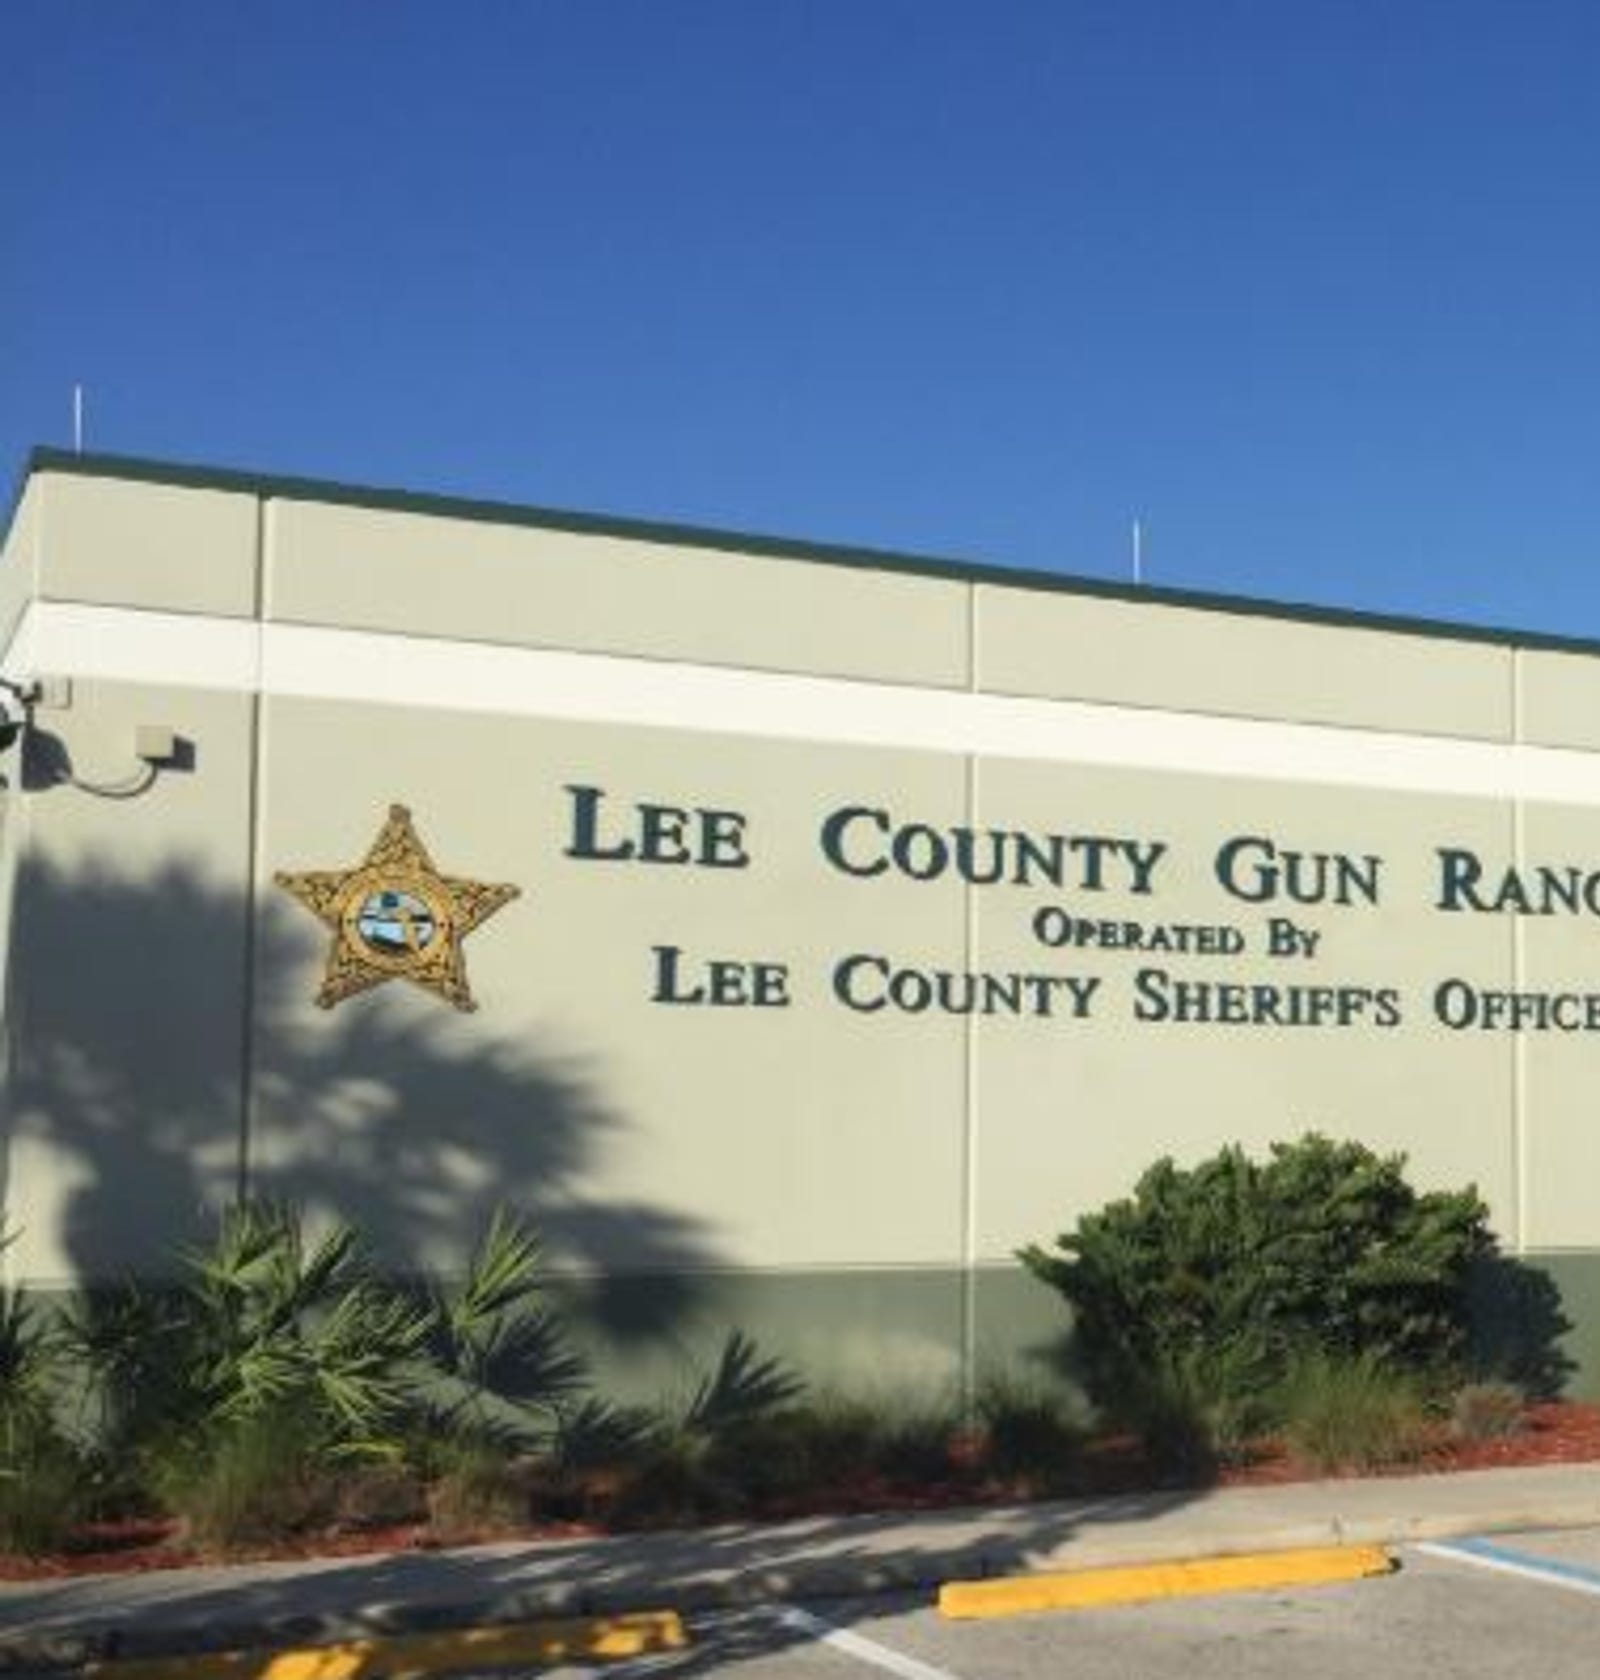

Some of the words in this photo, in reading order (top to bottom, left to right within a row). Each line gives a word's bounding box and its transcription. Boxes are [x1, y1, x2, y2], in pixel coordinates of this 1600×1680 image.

[563, 784, 750, 868] LEE
[820, 807, 1167, 894] COUNTY
[1215, 836, 1383, 905] GUN
[1033, 906, 1244, 955] OPERATED
[1267, 918, 1320, 958] BY
[650, 946, 791, 1006] LEE
[833, 954, 1100, 1018] COUNTY
[1134, 969, 1399, 1028] SHERIFF'S
